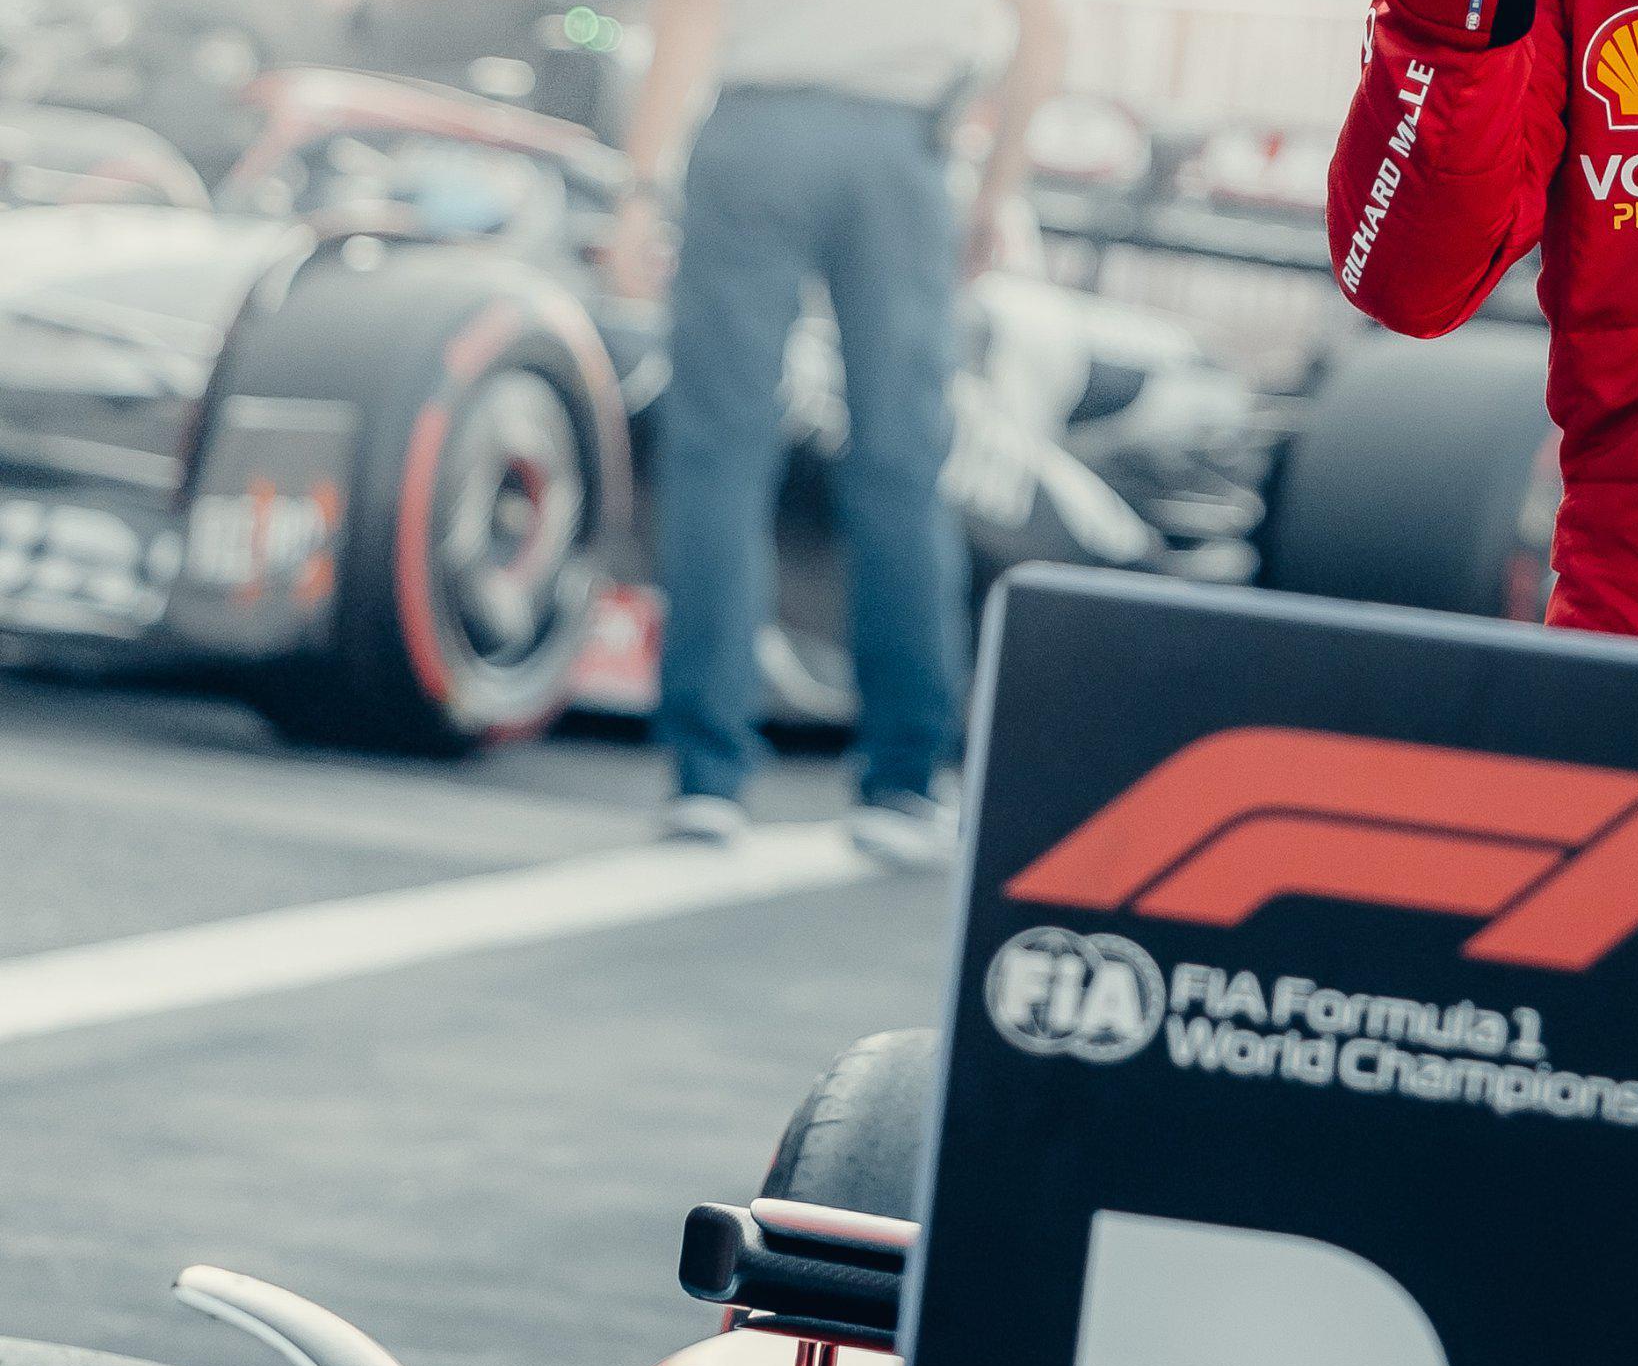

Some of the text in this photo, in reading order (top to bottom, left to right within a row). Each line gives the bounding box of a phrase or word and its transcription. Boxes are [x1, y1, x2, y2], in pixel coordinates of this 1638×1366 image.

[1341, 157, 1401, 295] RICHARD
[1163, 1012, 1338, 1087] World
[1169, 961, 1547, 1061] FIA Formula 1
